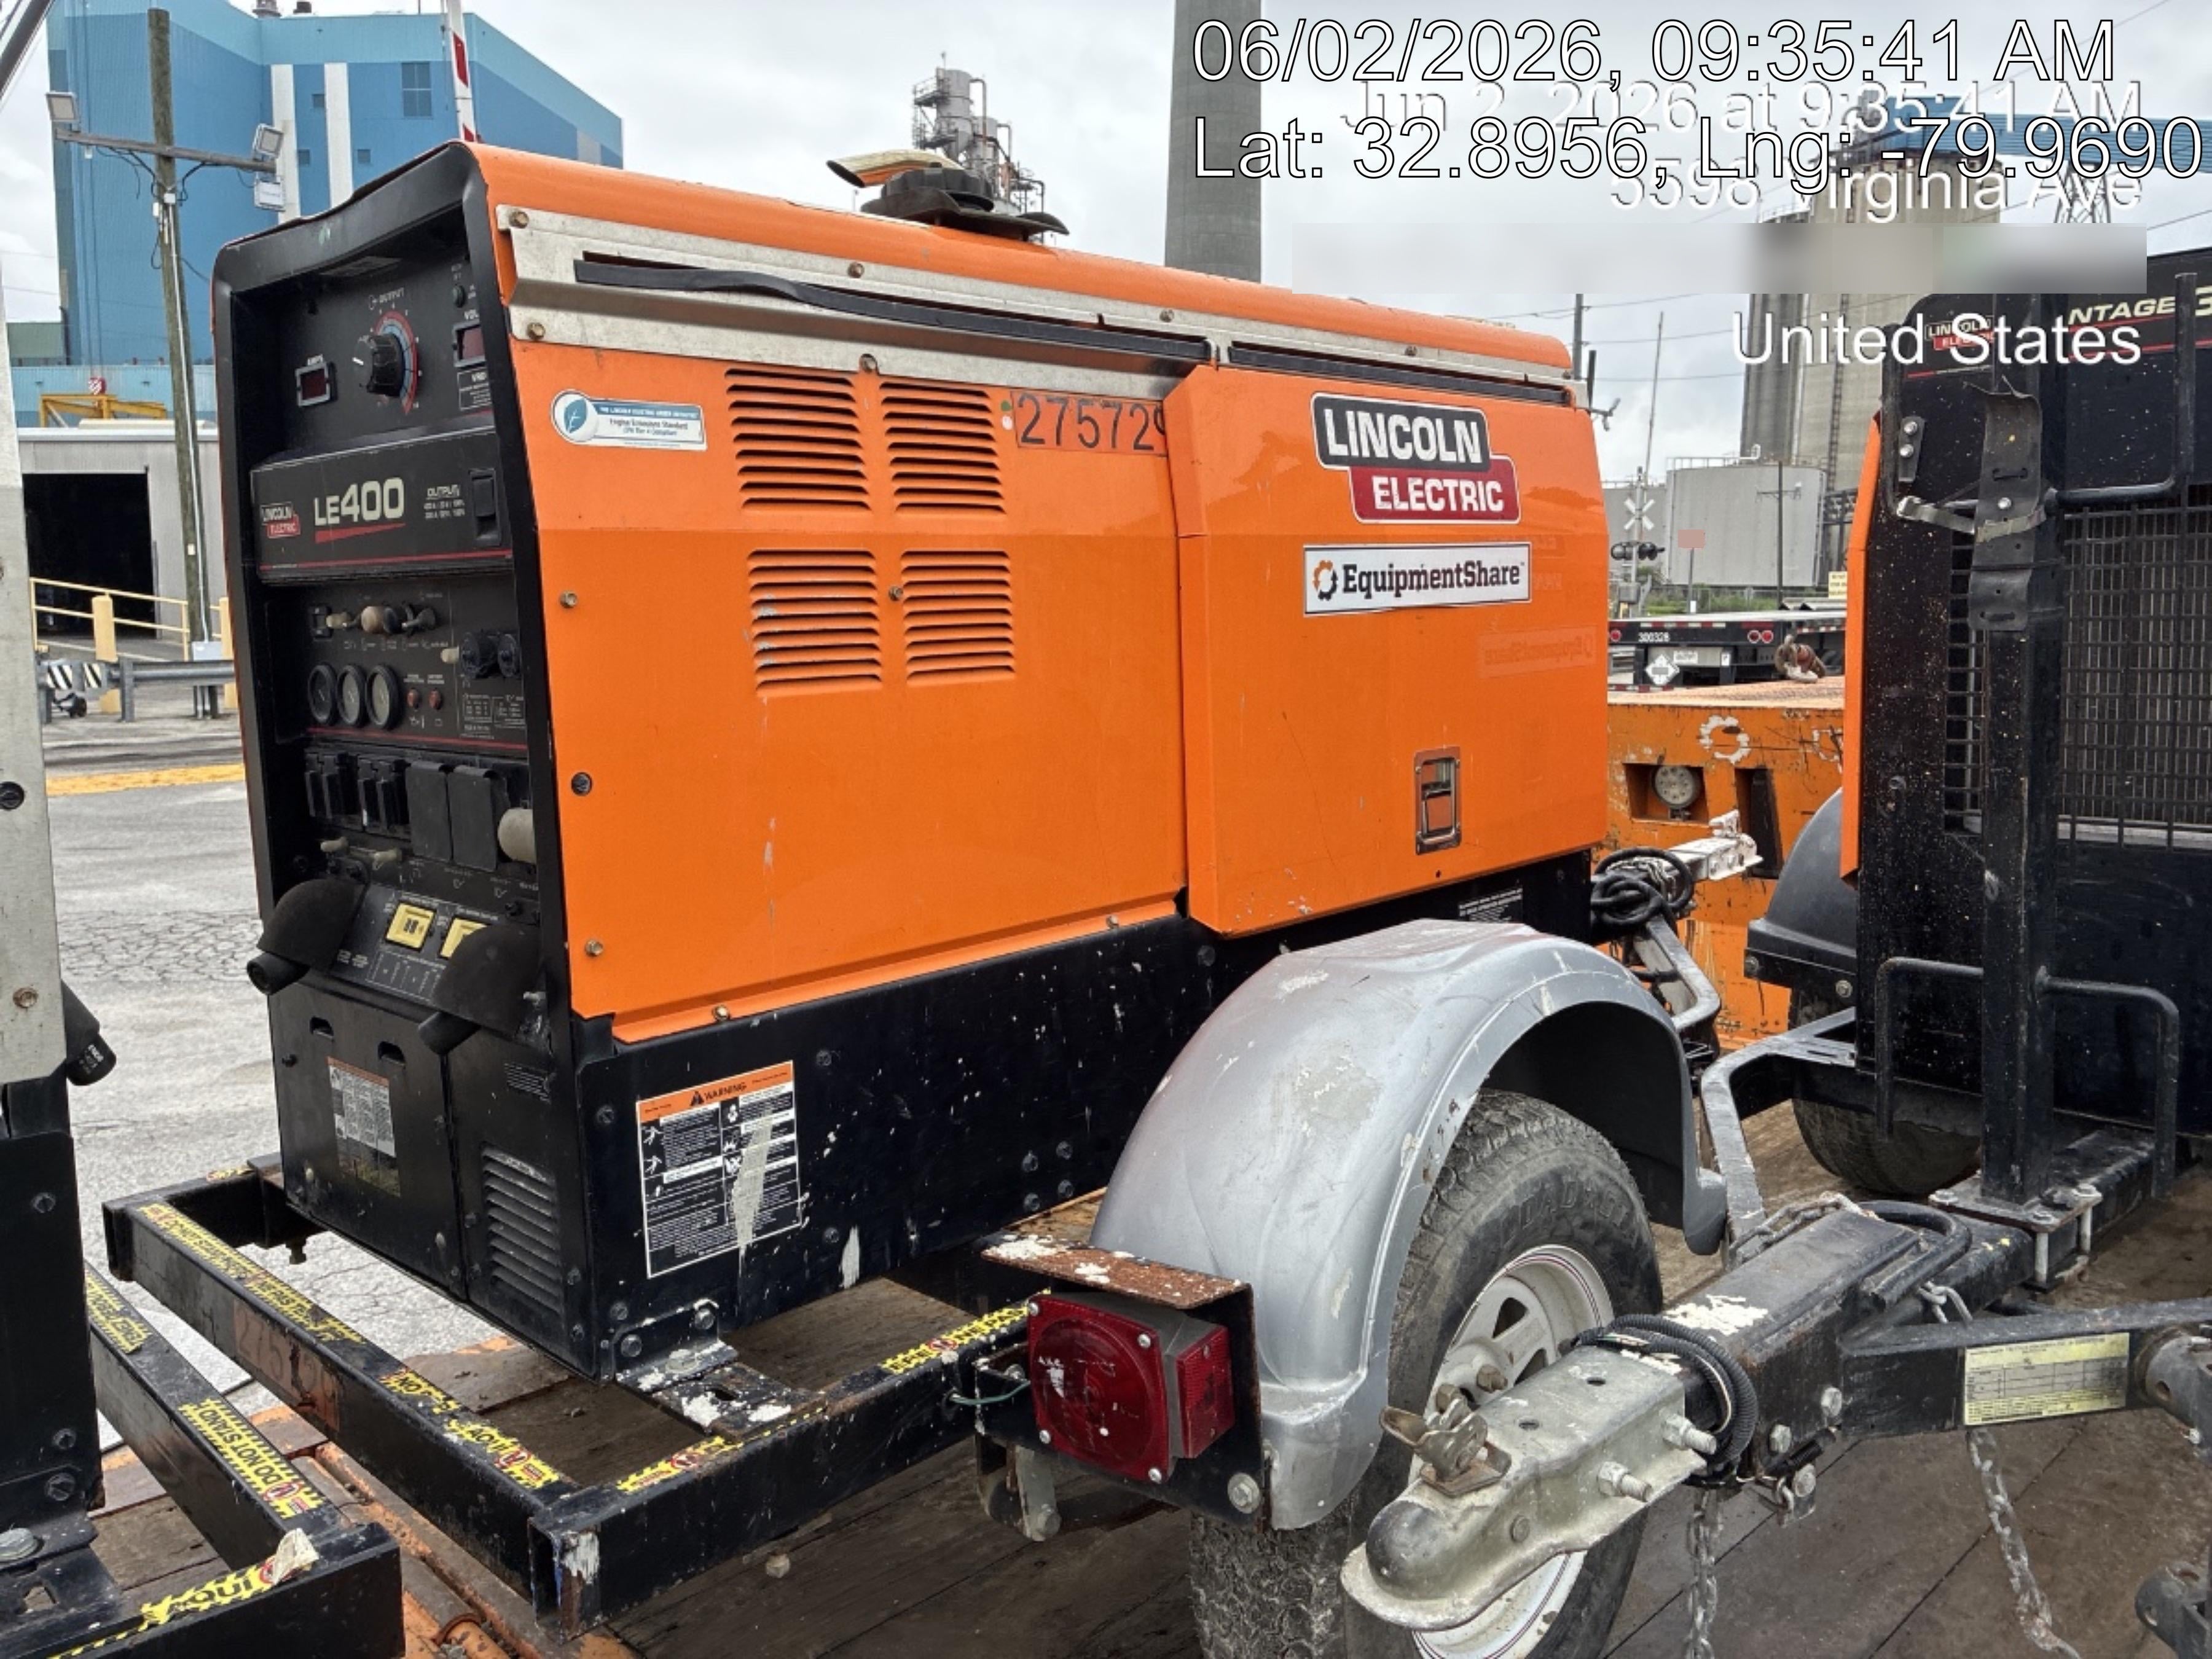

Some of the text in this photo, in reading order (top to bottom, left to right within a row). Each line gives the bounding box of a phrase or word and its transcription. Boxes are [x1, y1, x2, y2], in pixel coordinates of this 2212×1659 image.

[2068, 296, 2176, 324] NTAGE
[1324, 408, 1482, 463] LINCOLN
[315, 477, 404, 526] LE400
[1372, 475, 1504, 512] ELECTRIC
[1343, 559, 1520, 600] EquipmentShare
[705, 1082, 747, 1100] WARNING
[198, 1407, 282, 1485] DO NOT STAND
